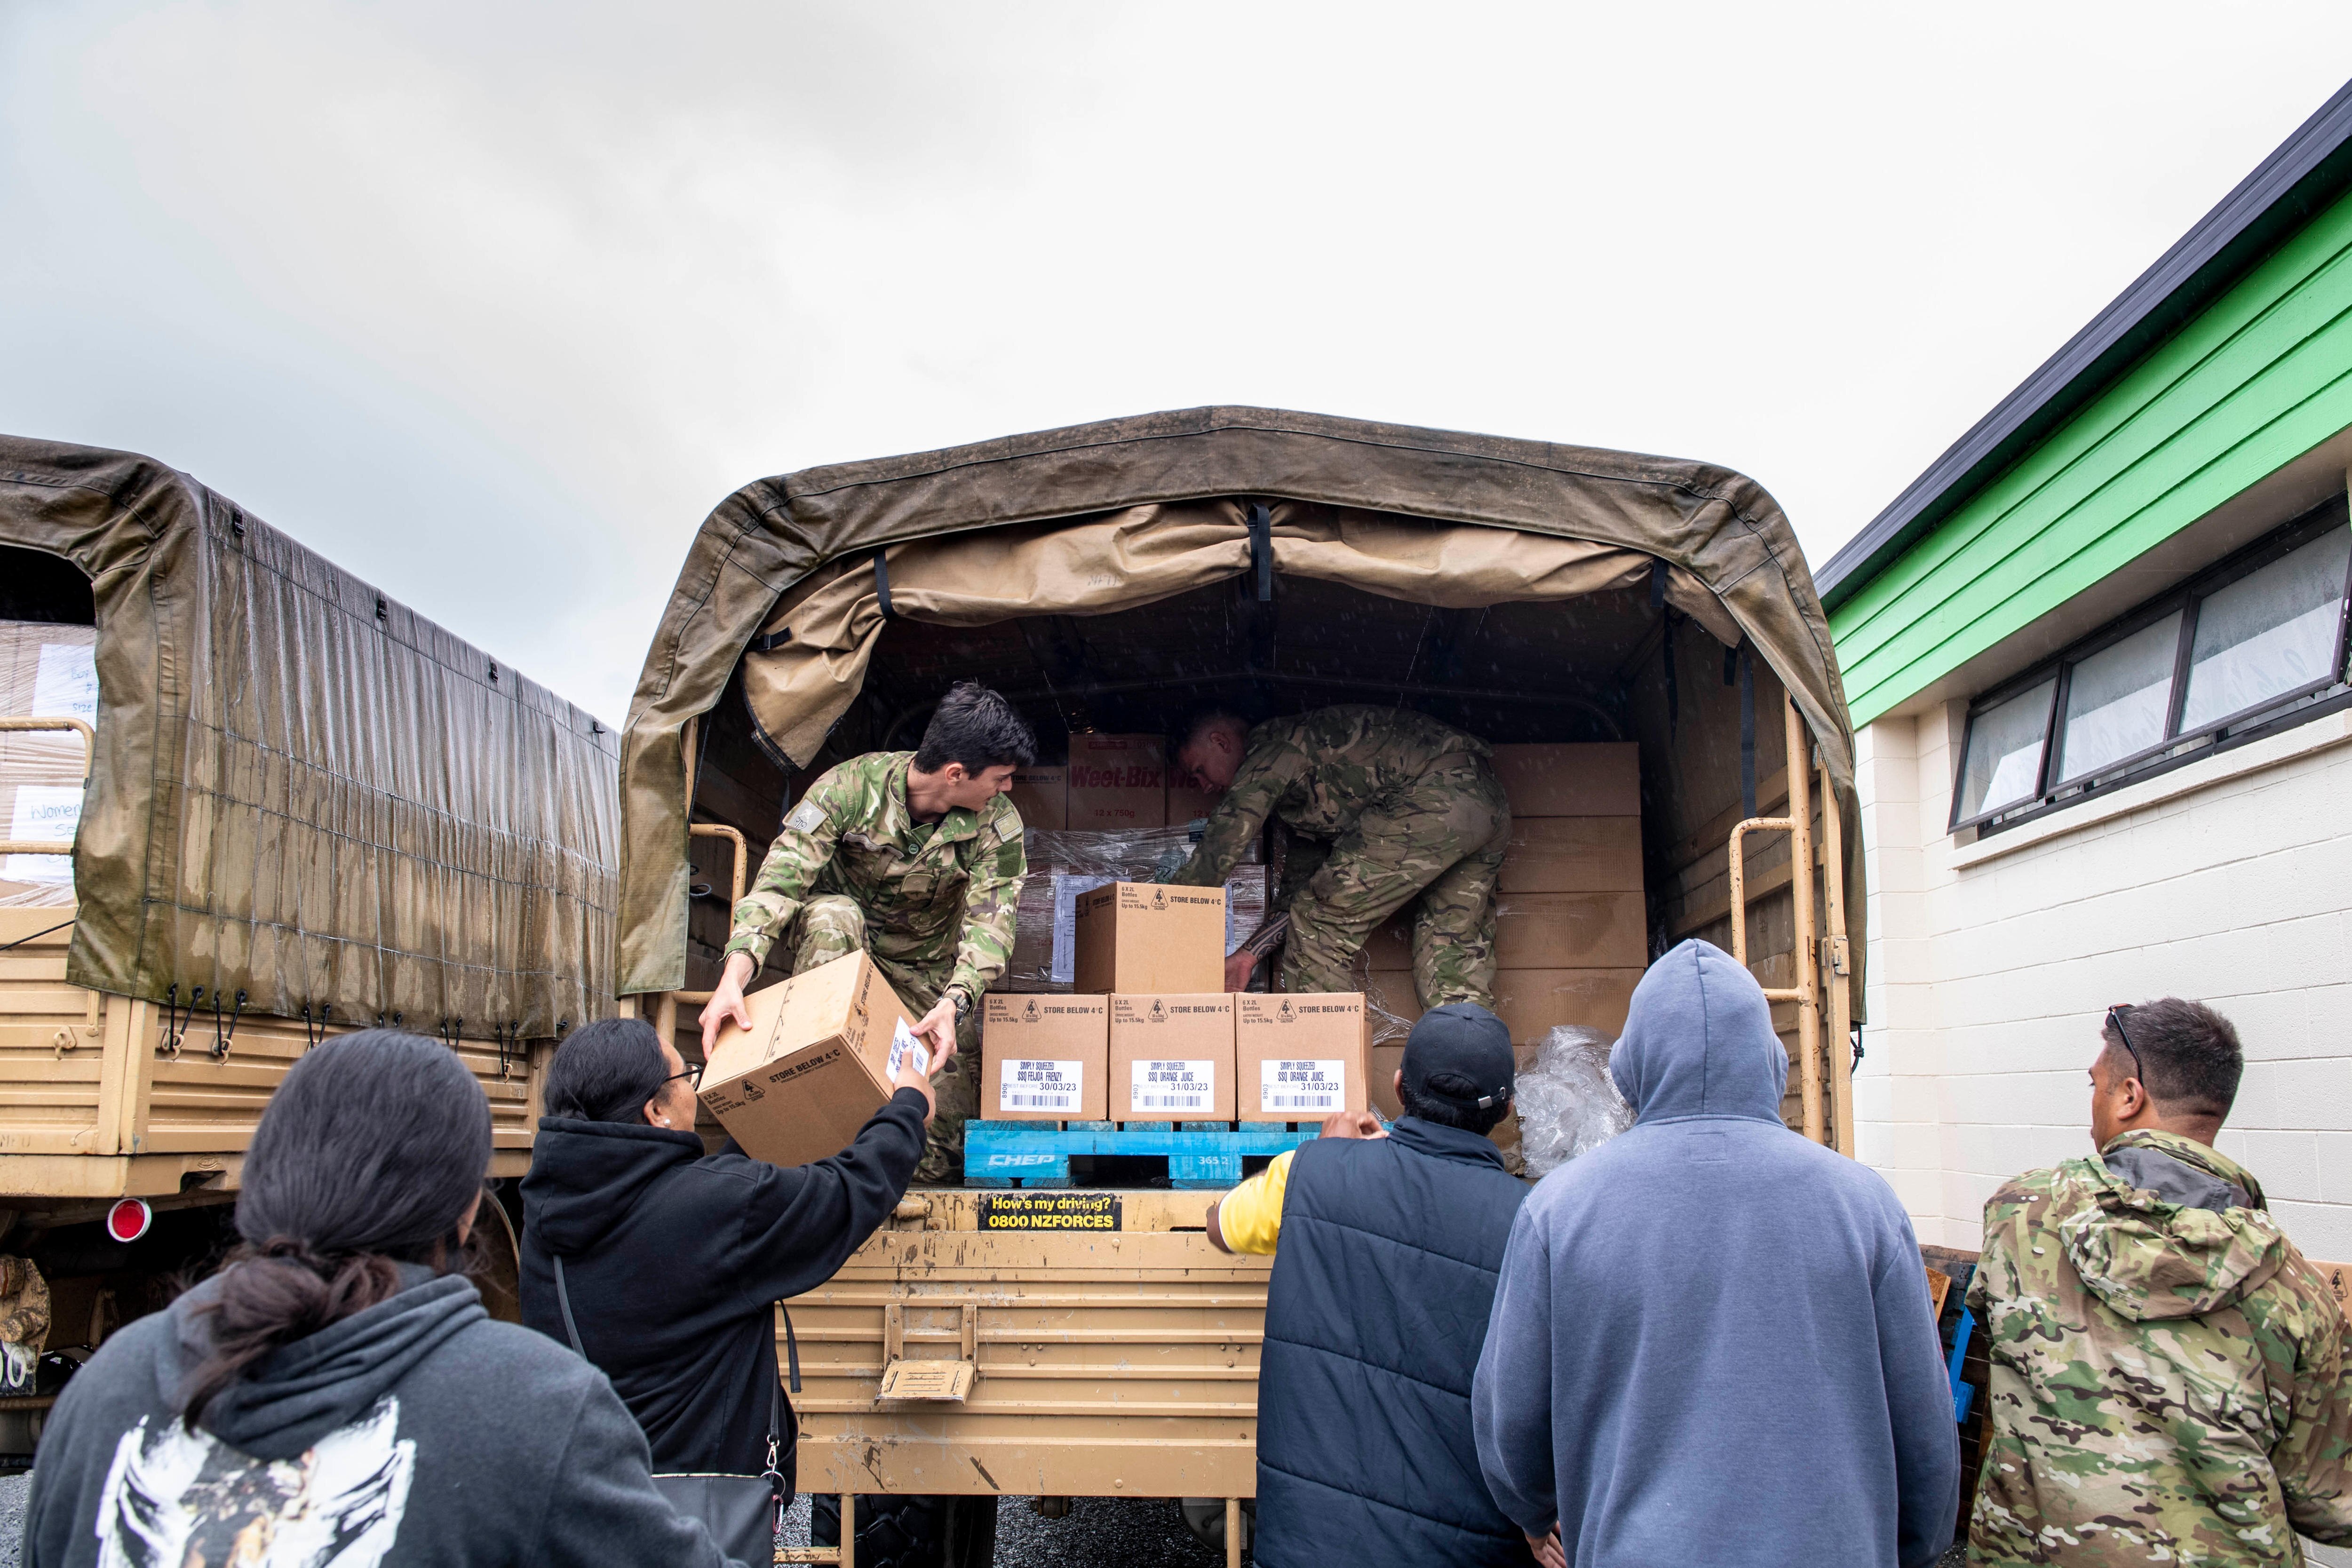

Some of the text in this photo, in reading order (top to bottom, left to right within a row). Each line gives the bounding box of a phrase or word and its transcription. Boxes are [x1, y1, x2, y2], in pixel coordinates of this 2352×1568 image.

[1071, 765, 1160, 788] Weet-Bix
[1114, 809, 1135, 818] 750g
[769, 1049, 841, 1082] STORE BELOW 4°C
[1020, 1061, 1054, 1071] SIMPLY SQUEEZED
[1151, 1062, 1185, 1071] SIMPLY SQUEEZED
[1296, 1062, 1315, 1071] SQUEEZED
[1018, 1071, 1062, 1082] SSQ FEIJOA FRENZY
[1148, 1072, 1193, 1082] SSQ ORANGE JUICE
[1278, 1072, 1324, 1082] SSQ ORANGE JUICE
[1040, 1082, 1076, 1091] 30/03/23
[707, 1095, 726, 1105] Bottles
[989, 1154, 1056, 1165] CHEP
[993, 1197, 1111, 1211] How's my driving?
[989, 1215, 1113, 1227] 0800 NZFORCES
